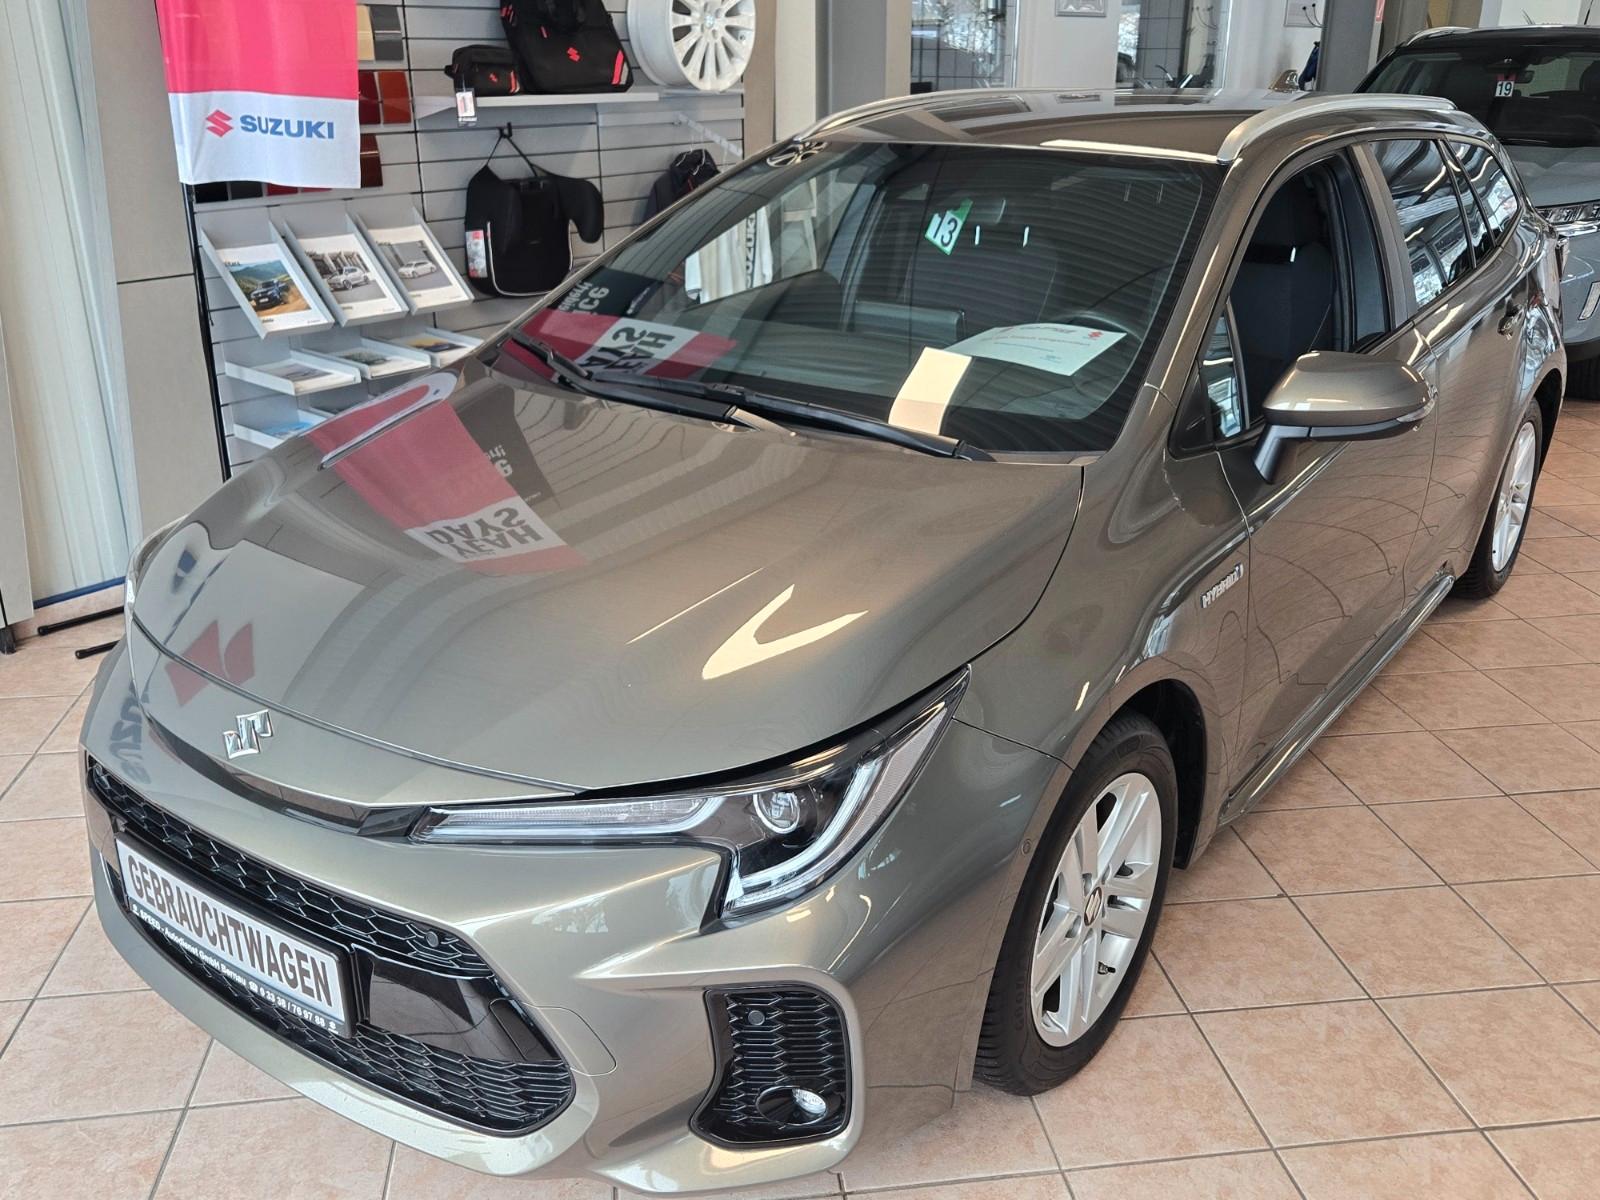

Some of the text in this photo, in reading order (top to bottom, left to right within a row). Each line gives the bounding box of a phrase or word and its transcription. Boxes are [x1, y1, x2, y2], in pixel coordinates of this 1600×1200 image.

[1499, 81, 1512, 96] 19
[240, 114, 335, 139] SUZUKI
[933, 211, 958, 247] 13
[1202, 563, 1244, 608] HYBRID
[128, 855, 333, 1007] GEBRAUCHTWAGEN
[164, 927, 199, 956] Autodienst
[199, 950, 221, 970] GmbH
[220, 963, 247, 986] Bernau
